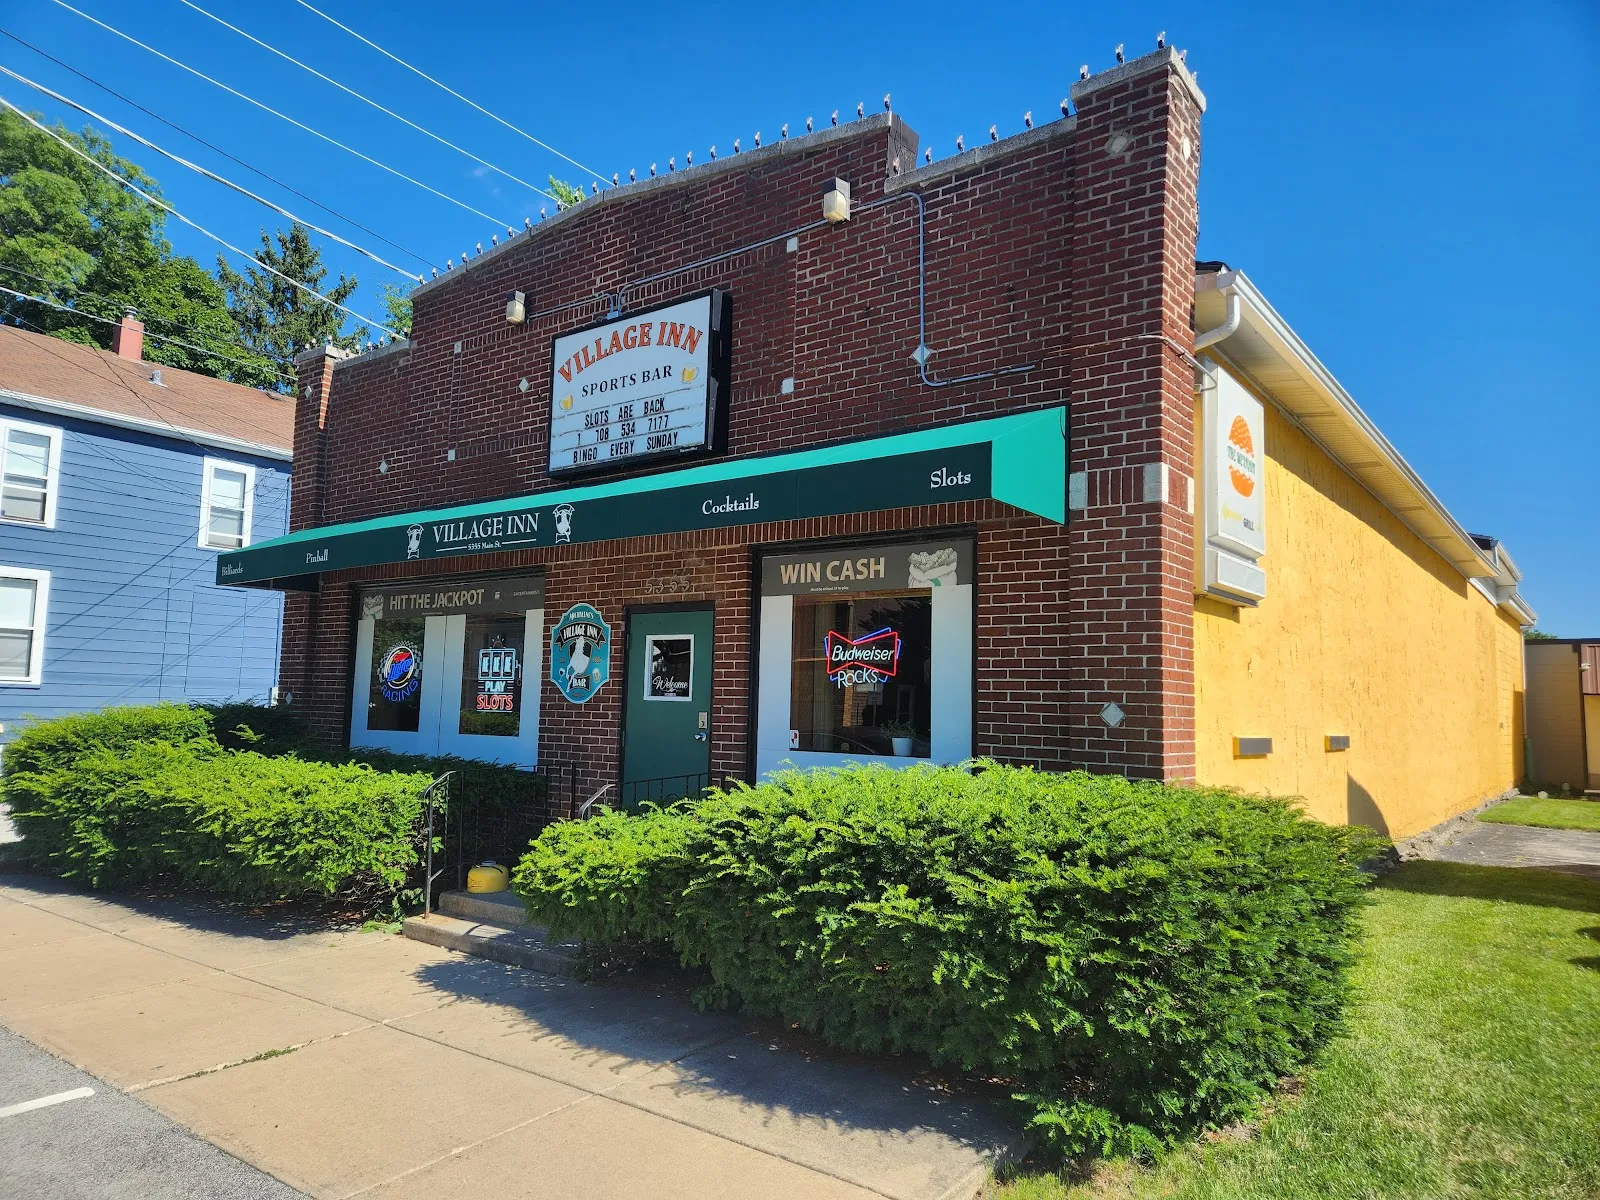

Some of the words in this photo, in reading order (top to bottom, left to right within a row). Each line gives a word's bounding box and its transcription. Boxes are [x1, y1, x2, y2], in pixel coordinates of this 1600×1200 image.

[557, 322, 652, 383] VILLAGE
[656, 321, 703, 355] INN
[581, 373, 636, 398] SPORTS
[642, 365, 673, 383] BAR
[584, 410, 609, 428] SLOTS
[618, 404, 633, 420] ARE
[644, 397, 665, 415] BACK
[577, 433, 581, 445] 1
[595, 427, 609, 442] 708
[621, 422, 636, 437] 534
[647, 415, 669, 430] 7177
[573, 447, 598, 464] BINGO
[610, 439, 635, 457] EVERY
[646, 432, 678, 450] SUNDAY
[930, 467, 972, 489] Slots
[702, 492, 760, 515] Cocktails
[432, 517, 503, 543] VILLAGE
[506, 512, 540, 535] INN
[305, 548, 329, 564] Pinball
[221, 562, 244, 576] Billiards
[780, 561, 821, 585] WIN
[826, 556, 885, 582] CASH
[644, 574, 690, 594] 5355
[389, 595, 408, 611] HIT
[409, 594, 431, 609] THE
[432, 588, 485, 609] JACKPOT
[563, 624, 586, 639] VILLAGE
[586, 625, 598, 639] INN
[831, 645, 895, 661] Budweiser
[484, 680, 506, 692] PLAY
[572, 678, 587, 688] BAR
[652, 675, 688, 690] Welcome
[837, 667, 879, 689] ROCKS
[380, 679, 419, 702] RACING
[476, 694, 514, 711] SLOTS
